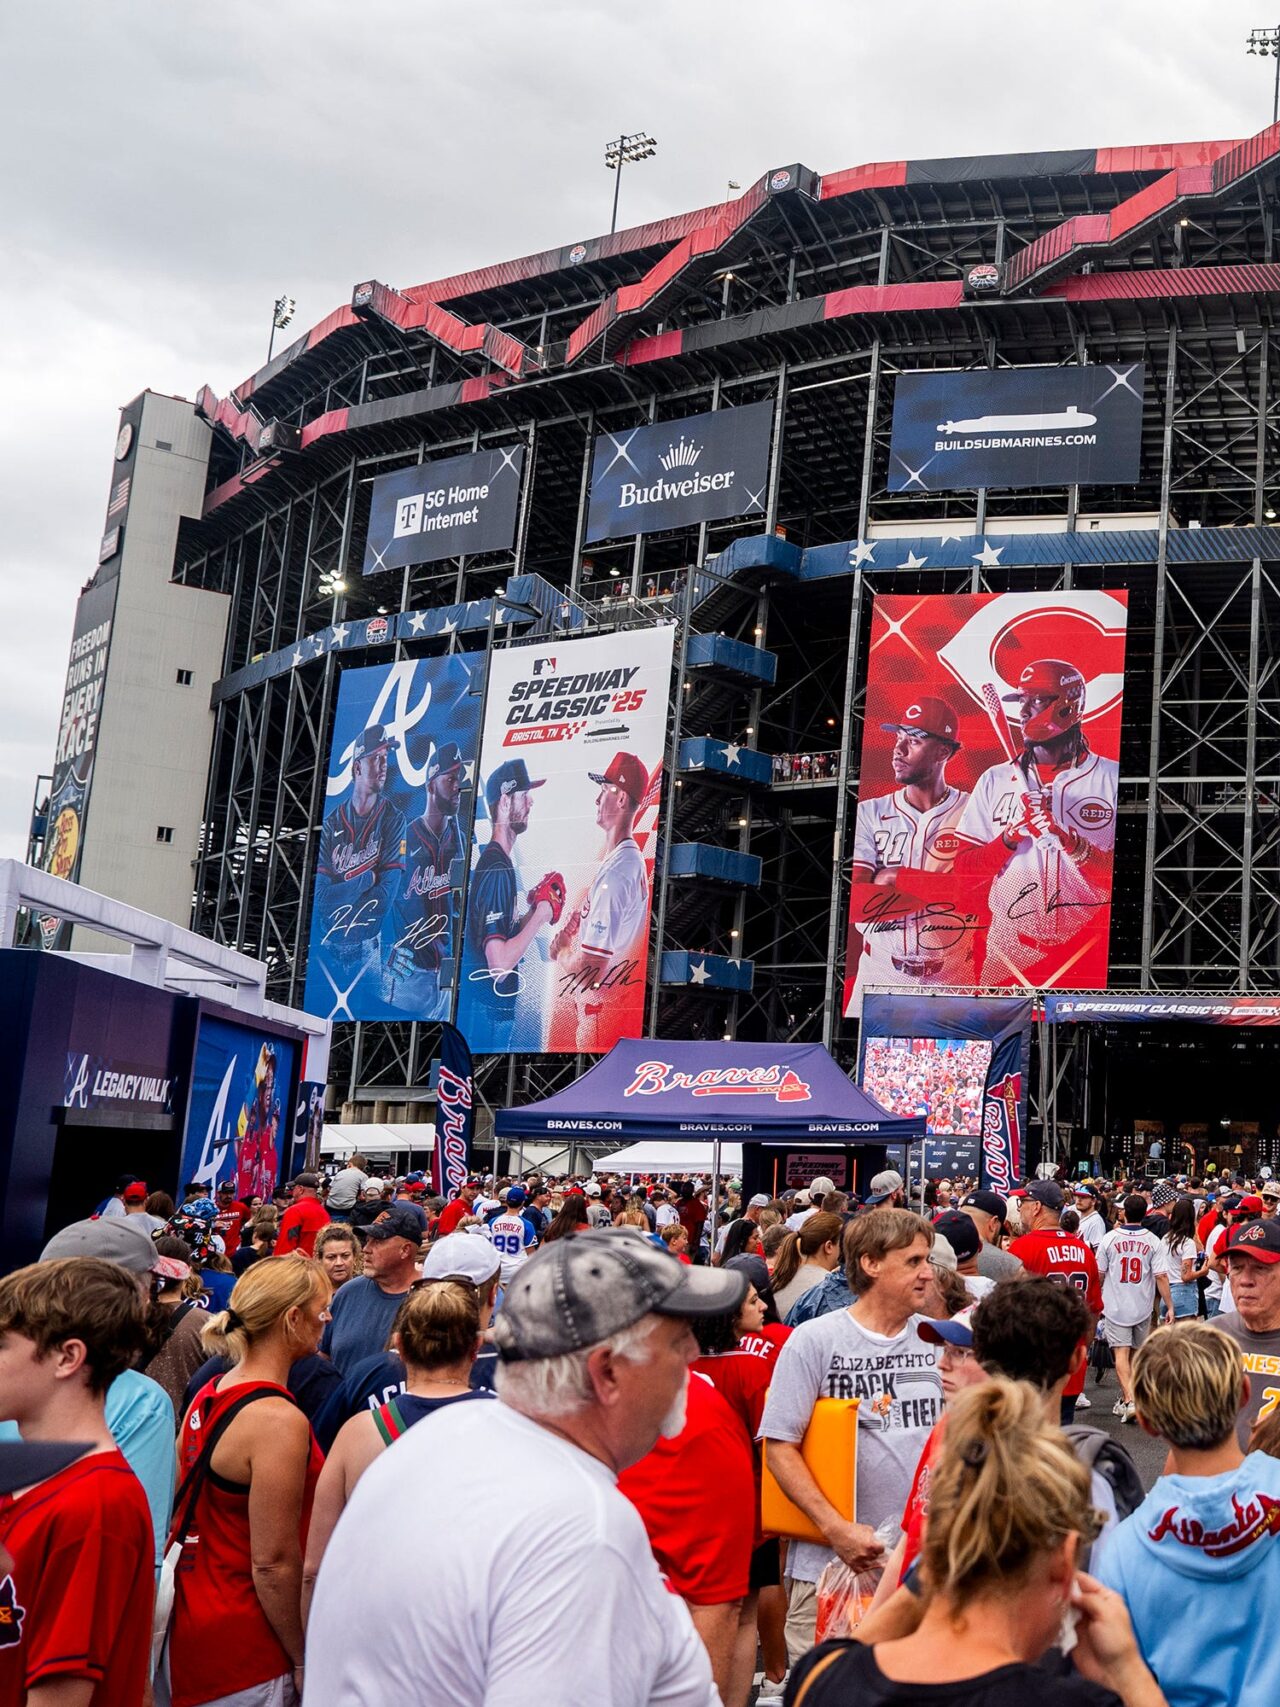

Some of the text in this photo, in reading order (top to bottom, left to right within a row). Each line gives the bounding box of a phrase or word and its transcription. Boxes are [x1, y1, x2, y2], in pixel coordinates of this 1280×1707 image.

[933, 433, 1098, 452] BUILDSUBMARINES.COM
[425, 483, 490, 511] 5G Home
[618, 469, 736, 509] Budweiser
[422, 505, 479, 533] Internet
[70, 619, 112, 664] FREEDOM
[67, 646, 108, 690] RUNS IN
[508, 666, 641, 703] SPEEDWAY
[62, 676, 104, 722] EVERY
[505, 693, 612, 726] CLASSIC
[55, 712, 97, 767] RACE
[509, 726, 559, 743] BRISTOL, TN
[1080, 808, 1113, 820] REDS
[935, 838, 960, 850] RED
[403, 864, 451, 900] Atlan
[1074, 1003, 1151, 1013] SPEEDWAY
[1149, 1004, 1210, 1015] CLASSIC
[92, 1070, 173, 1103] LEGACY WALK
[623, 1060, 781, 1098] Braves
[547, 1119, 622, 1131] BRAVES.COM
[679, 1122, 753, 1132] BRAVES.COM
[807, 1122, 880, 1132] BRAVES.COM
[493, 1223, 523, 1234] STRIDER
[493, 1234, 520, 1255] 99
[1046, 1246, 1086, 1265] OLSON
[1114, 1240, 1150, 1256] VOTTO
[1119, 1256, 1143, 1285] 19
[830, 1353, 936, 1371] ELIZABETHTO
[826, 1372, 898, 1400] TRACK
[1149, 1488, 1261, 1548] Atlanta
